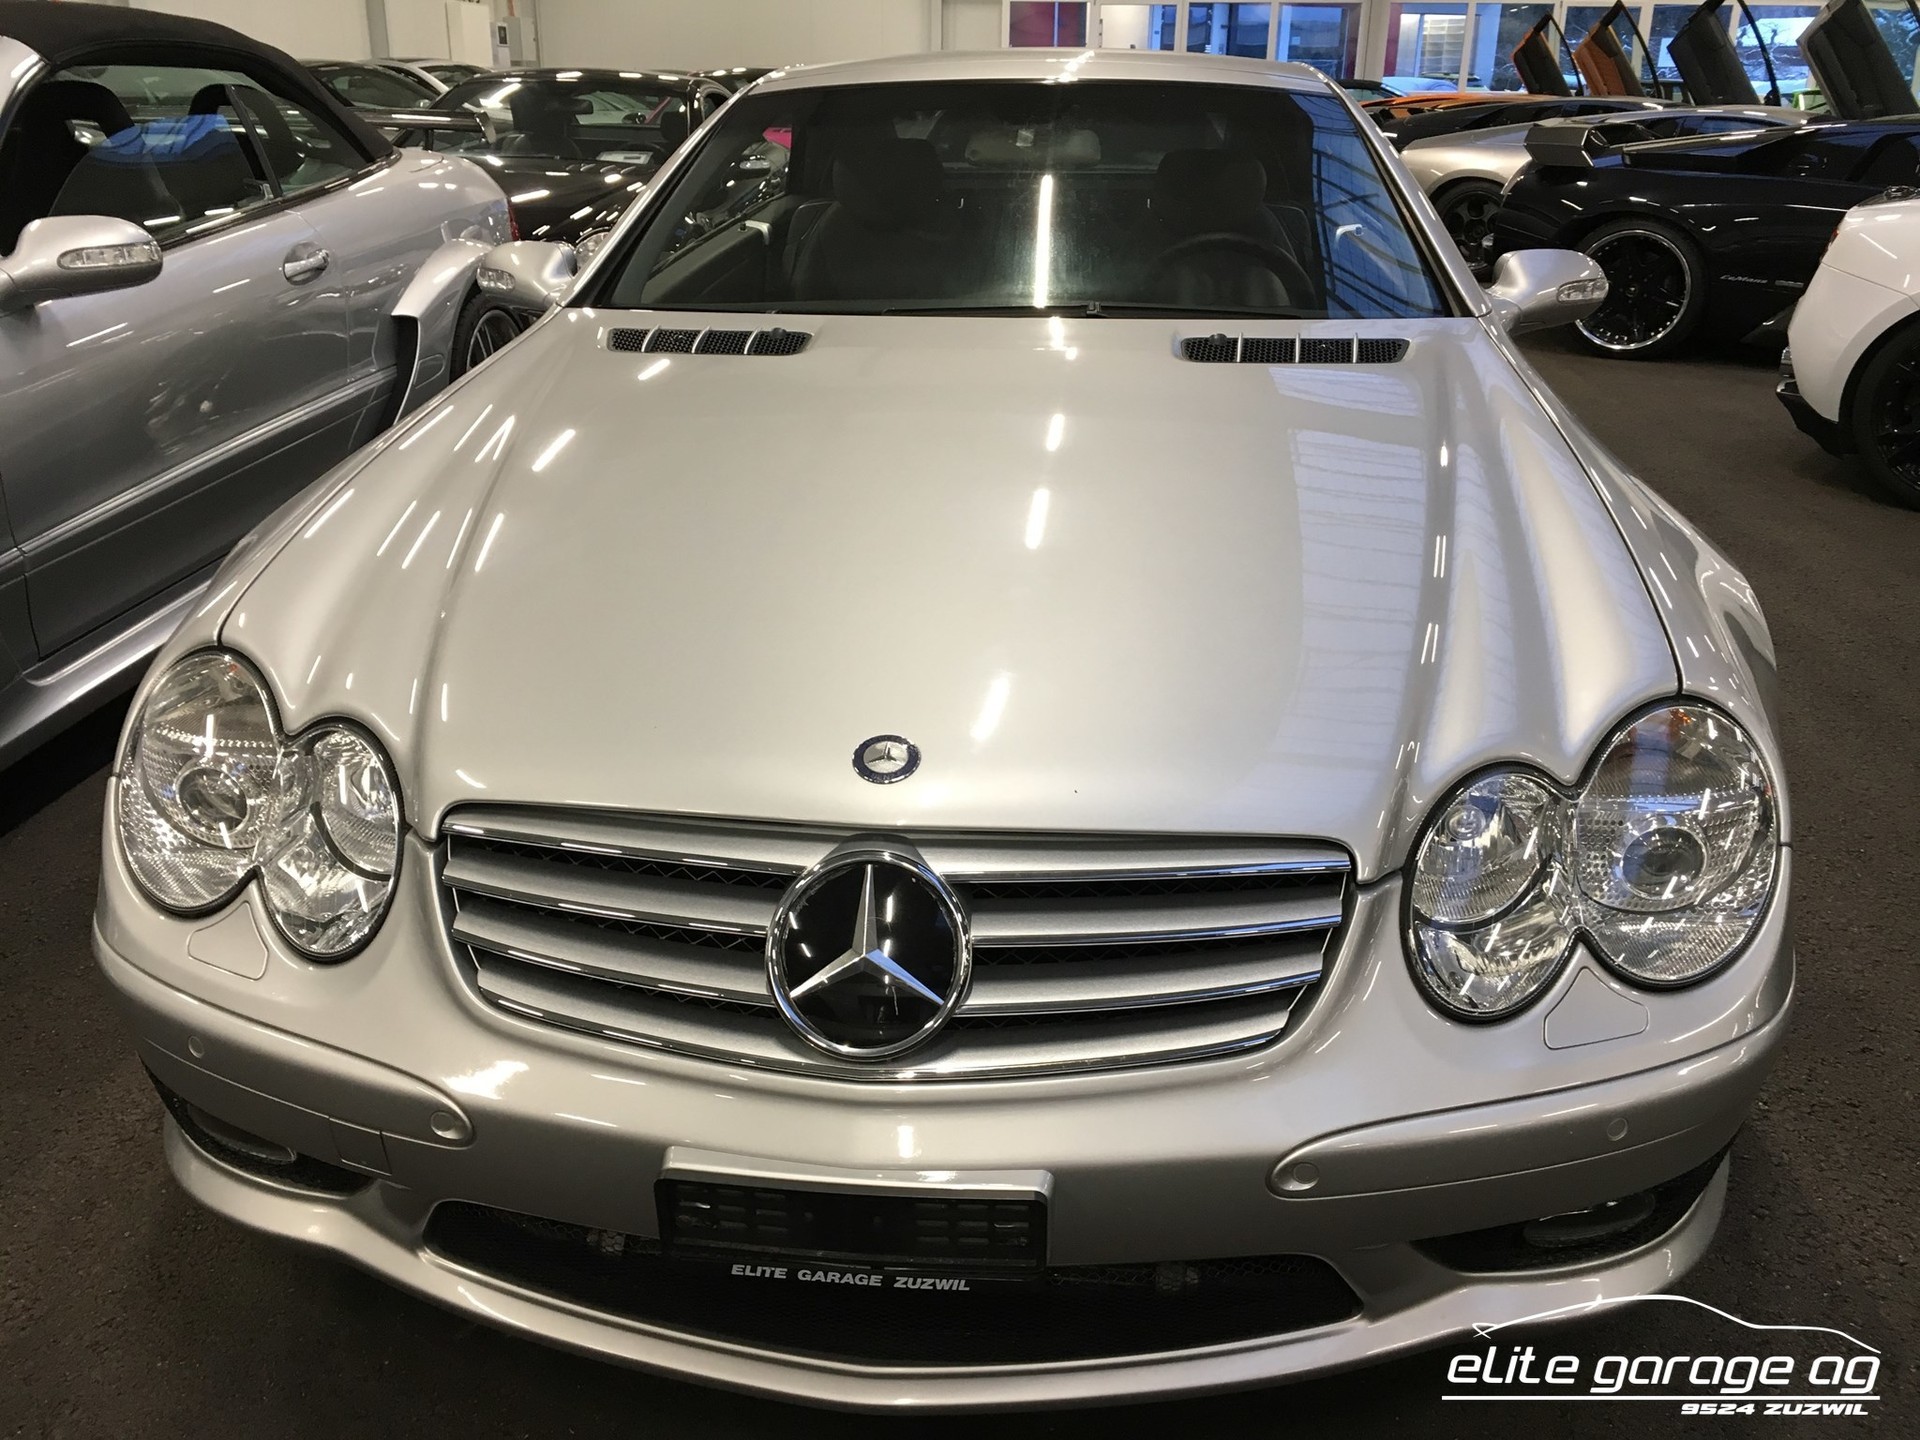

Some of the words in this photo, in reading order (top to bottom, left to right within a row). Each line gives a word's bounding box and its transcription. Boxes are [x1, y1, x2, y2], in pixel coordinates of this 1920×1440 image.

[731, 1264, 788, 1279] ELITE
[797, 1269, 883, 1287] GARAGE
[893, 1276, 971, 1291] ZUZWIL
